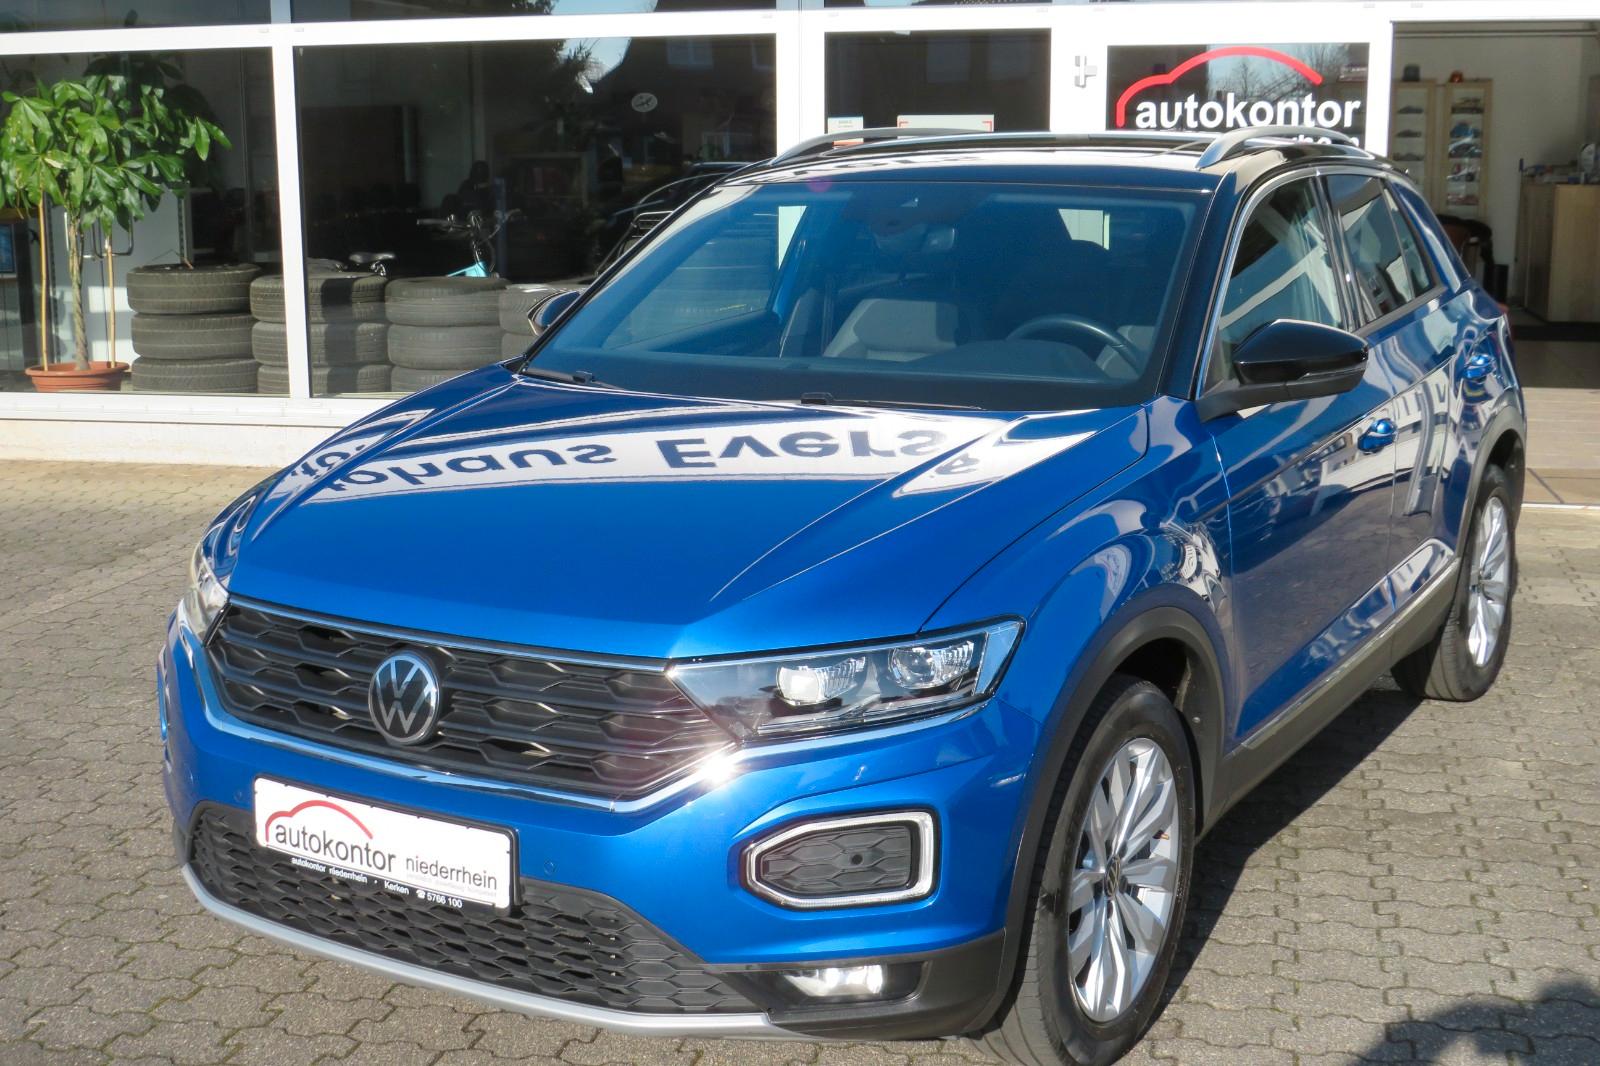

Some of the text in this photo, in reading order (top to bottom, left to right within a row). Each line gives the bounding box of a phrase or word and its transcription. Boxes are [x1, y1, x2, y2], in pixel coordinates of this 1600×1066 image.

[1135, 92, 1361, 128] autokontor
[370, 656, 438, 740] VW
[275, 823, 397, 873] autokontor
[405, 855, 498, 891] niederrhein
[291, 856, 327, 873] autokontor
[329, 866, 368, 884] niederrhein
[384, 880, 410, 896] Kerken
[448, 897, 463, 908] 100
